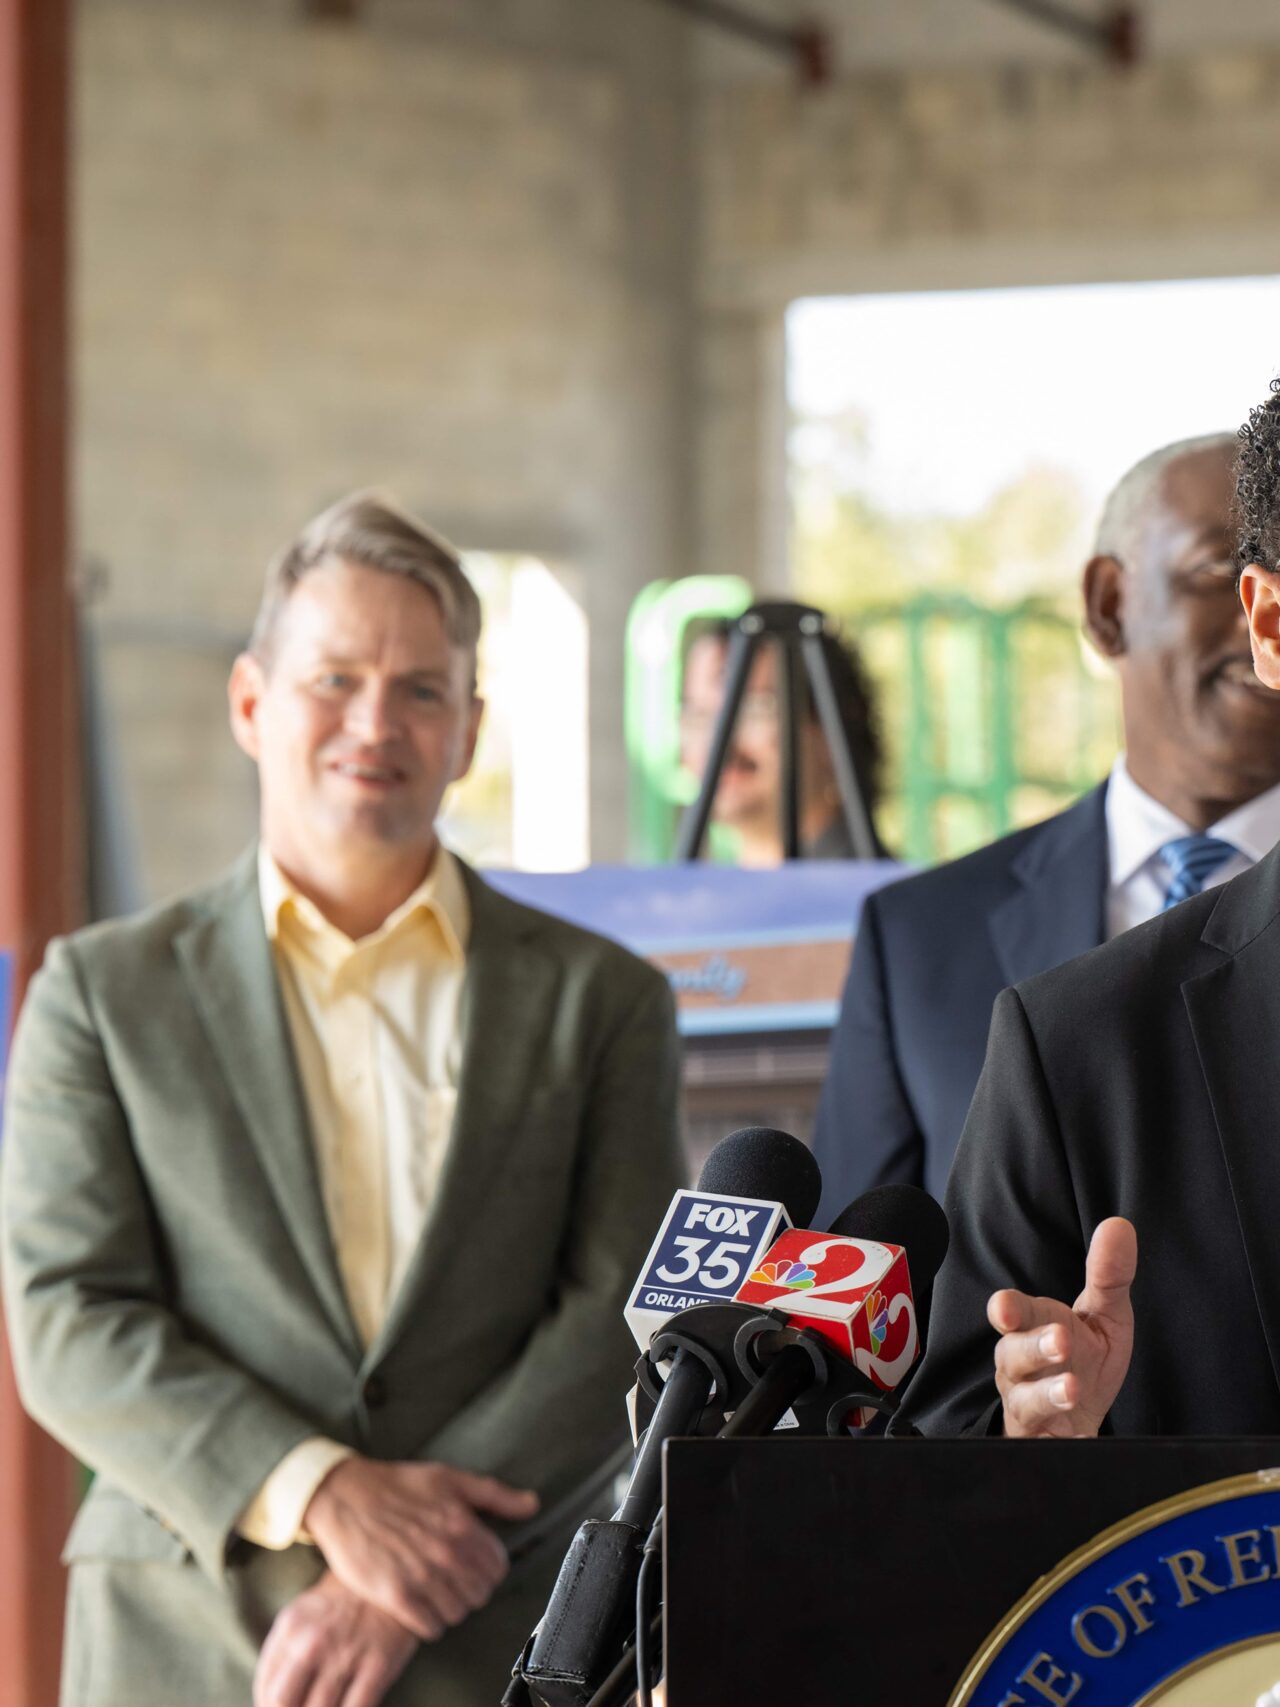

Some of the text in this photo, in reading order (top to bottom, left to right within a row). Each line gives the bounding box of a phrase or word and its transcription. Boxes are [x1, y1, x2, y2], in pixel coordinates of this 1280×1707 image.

[684, 1203, 759, 1236] FOX
[655, 1235, 751, 1289] 35
[764, 1239, 894, 1320] 2
[644, 1292, 710, 1309] ORLAN
[1071, 1572, 1155, 1658] OF
